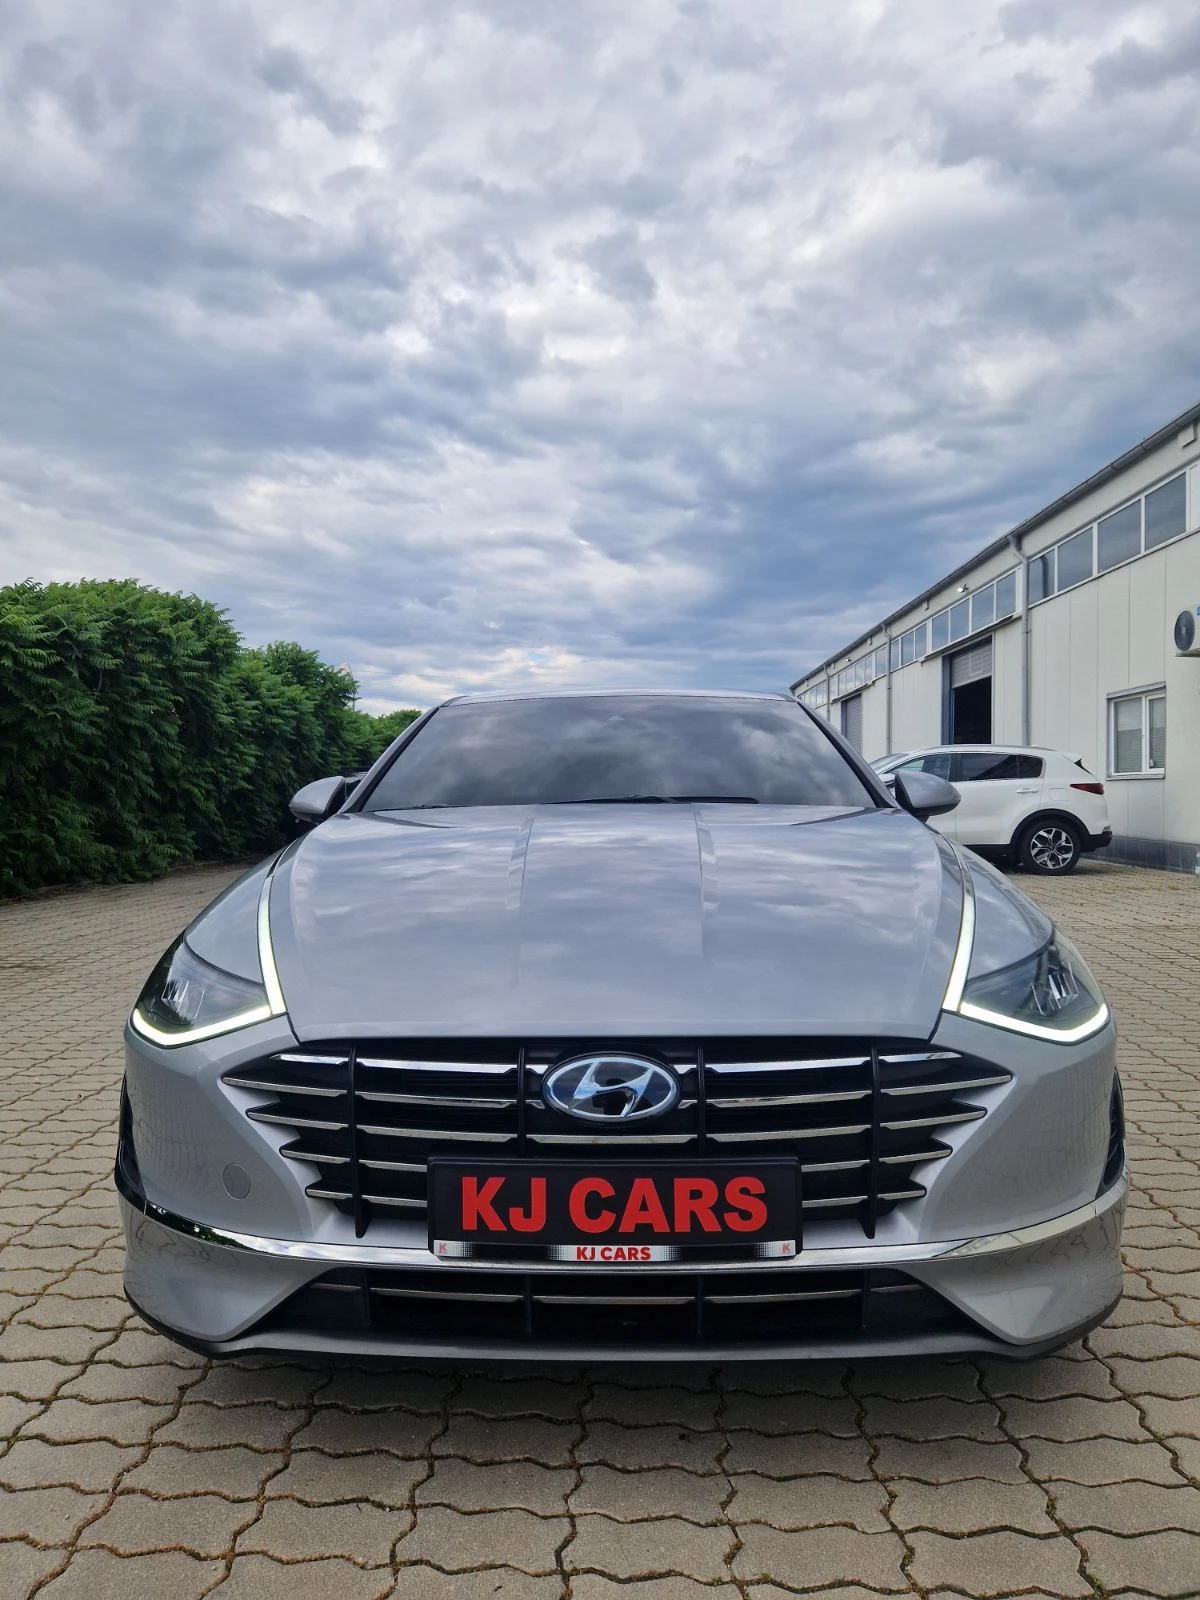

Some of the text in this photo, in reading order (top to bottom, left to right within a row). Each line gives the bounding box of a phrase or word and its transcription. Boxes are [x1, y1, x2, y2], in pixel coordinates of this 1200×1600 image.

[461, 1176, 768, 1233] KJ CARS
[576, 1246, 652, 1261] KJ CARS
